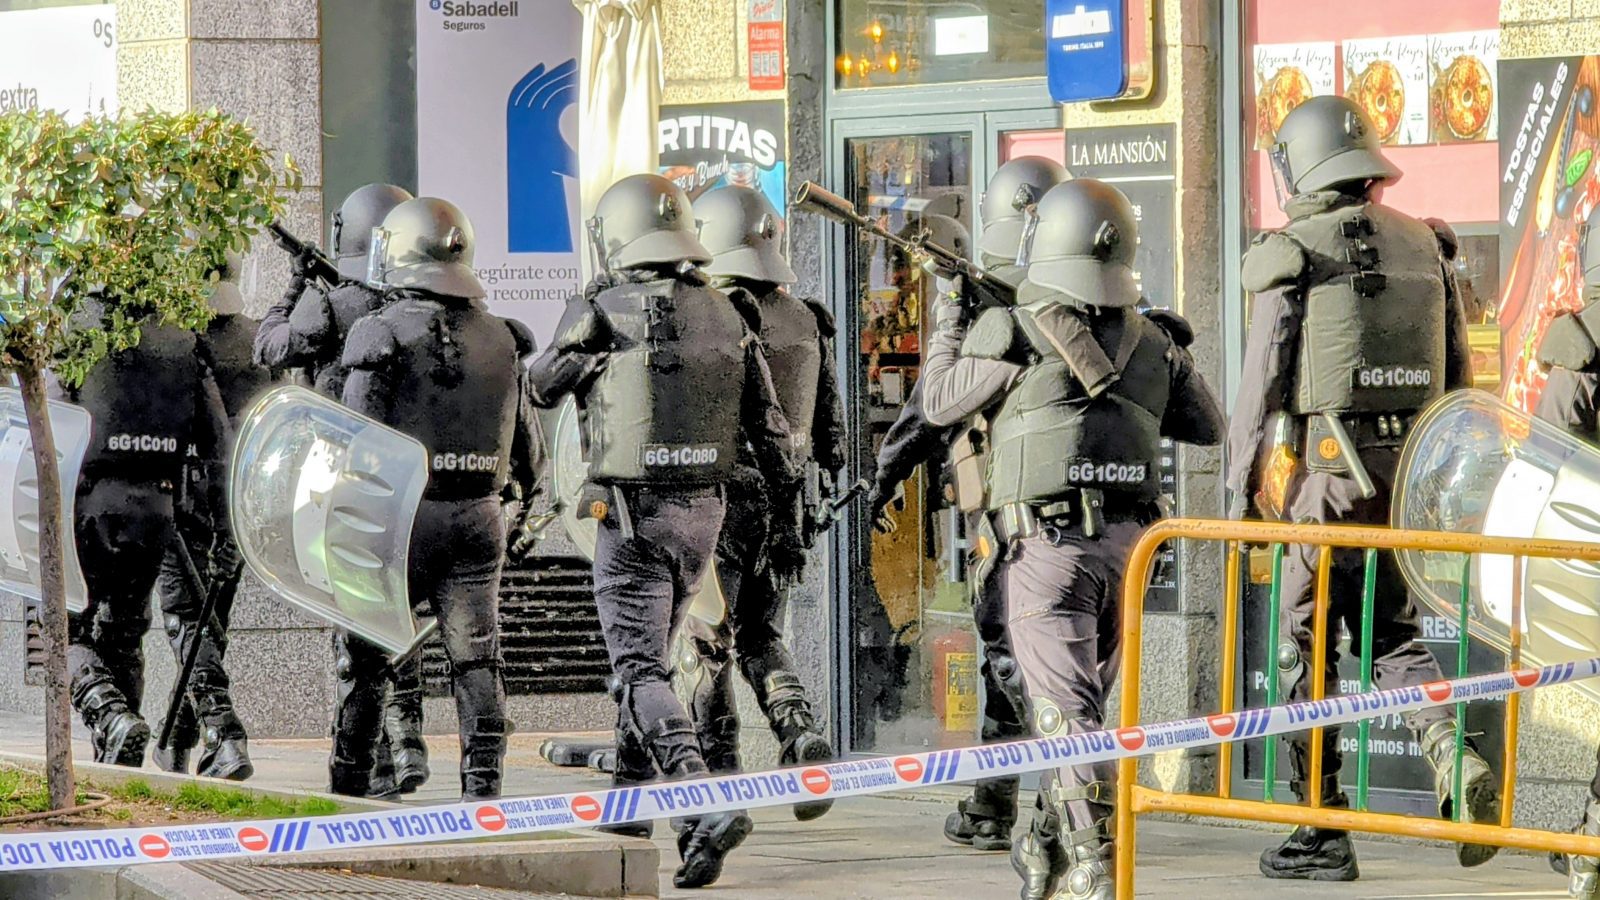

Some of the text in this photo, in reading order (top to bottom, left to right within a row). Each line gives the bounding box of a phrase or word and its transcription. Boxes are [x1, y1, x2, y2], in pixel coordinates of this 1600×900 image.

[442, 0, 518, 17] Sabadell
[443, 20, 486, 32] Seguros
[658, 115, 778, 167] RTITAS
[1504, 81, 1544, 184] TOSTAS
[1072, 134, 1167, 166] LA MANSIÓN
[1506, 62, 1568, 228] ESPECIALES
[474, 263, 578, 285] segúrate con
[493, 283, 580, 301] recomend
[1360, 367, 1431, 386] 6G1C060
[108, 434, 177, 452] 6G1C010
[433, 452, 500, 471] 6G1C097
[645, 447, 718, 466] 6G1C080
[1068, 462, 1146, 482] 6G1C023
[1422, 616, 1460, 638] RES
[1454, 684, 1470, 698] PASO
[1146, 726, 1210, 748] PROHIBIDO EL PASO
[968, 731, 1116, 770] POLICIA LOCAL
[648, 772, 800, 811] POLICIA LOCAL
[832, 772, 898, 792] PROHIBIDO EL PASO
[500, 796, 569, 814] LINEA DE POLICIA
[316, 810, 473, 844] POLICIA LOCAL
[506, 812, 574, 829] PROHIBIDO EL PASO
[164, 826, 235, 842] LINEA DE POLICIA
[0, 837, 137, 866] POLICIA LOC
[171, 842, 241, 857] PROHIBIDO EL PASO
